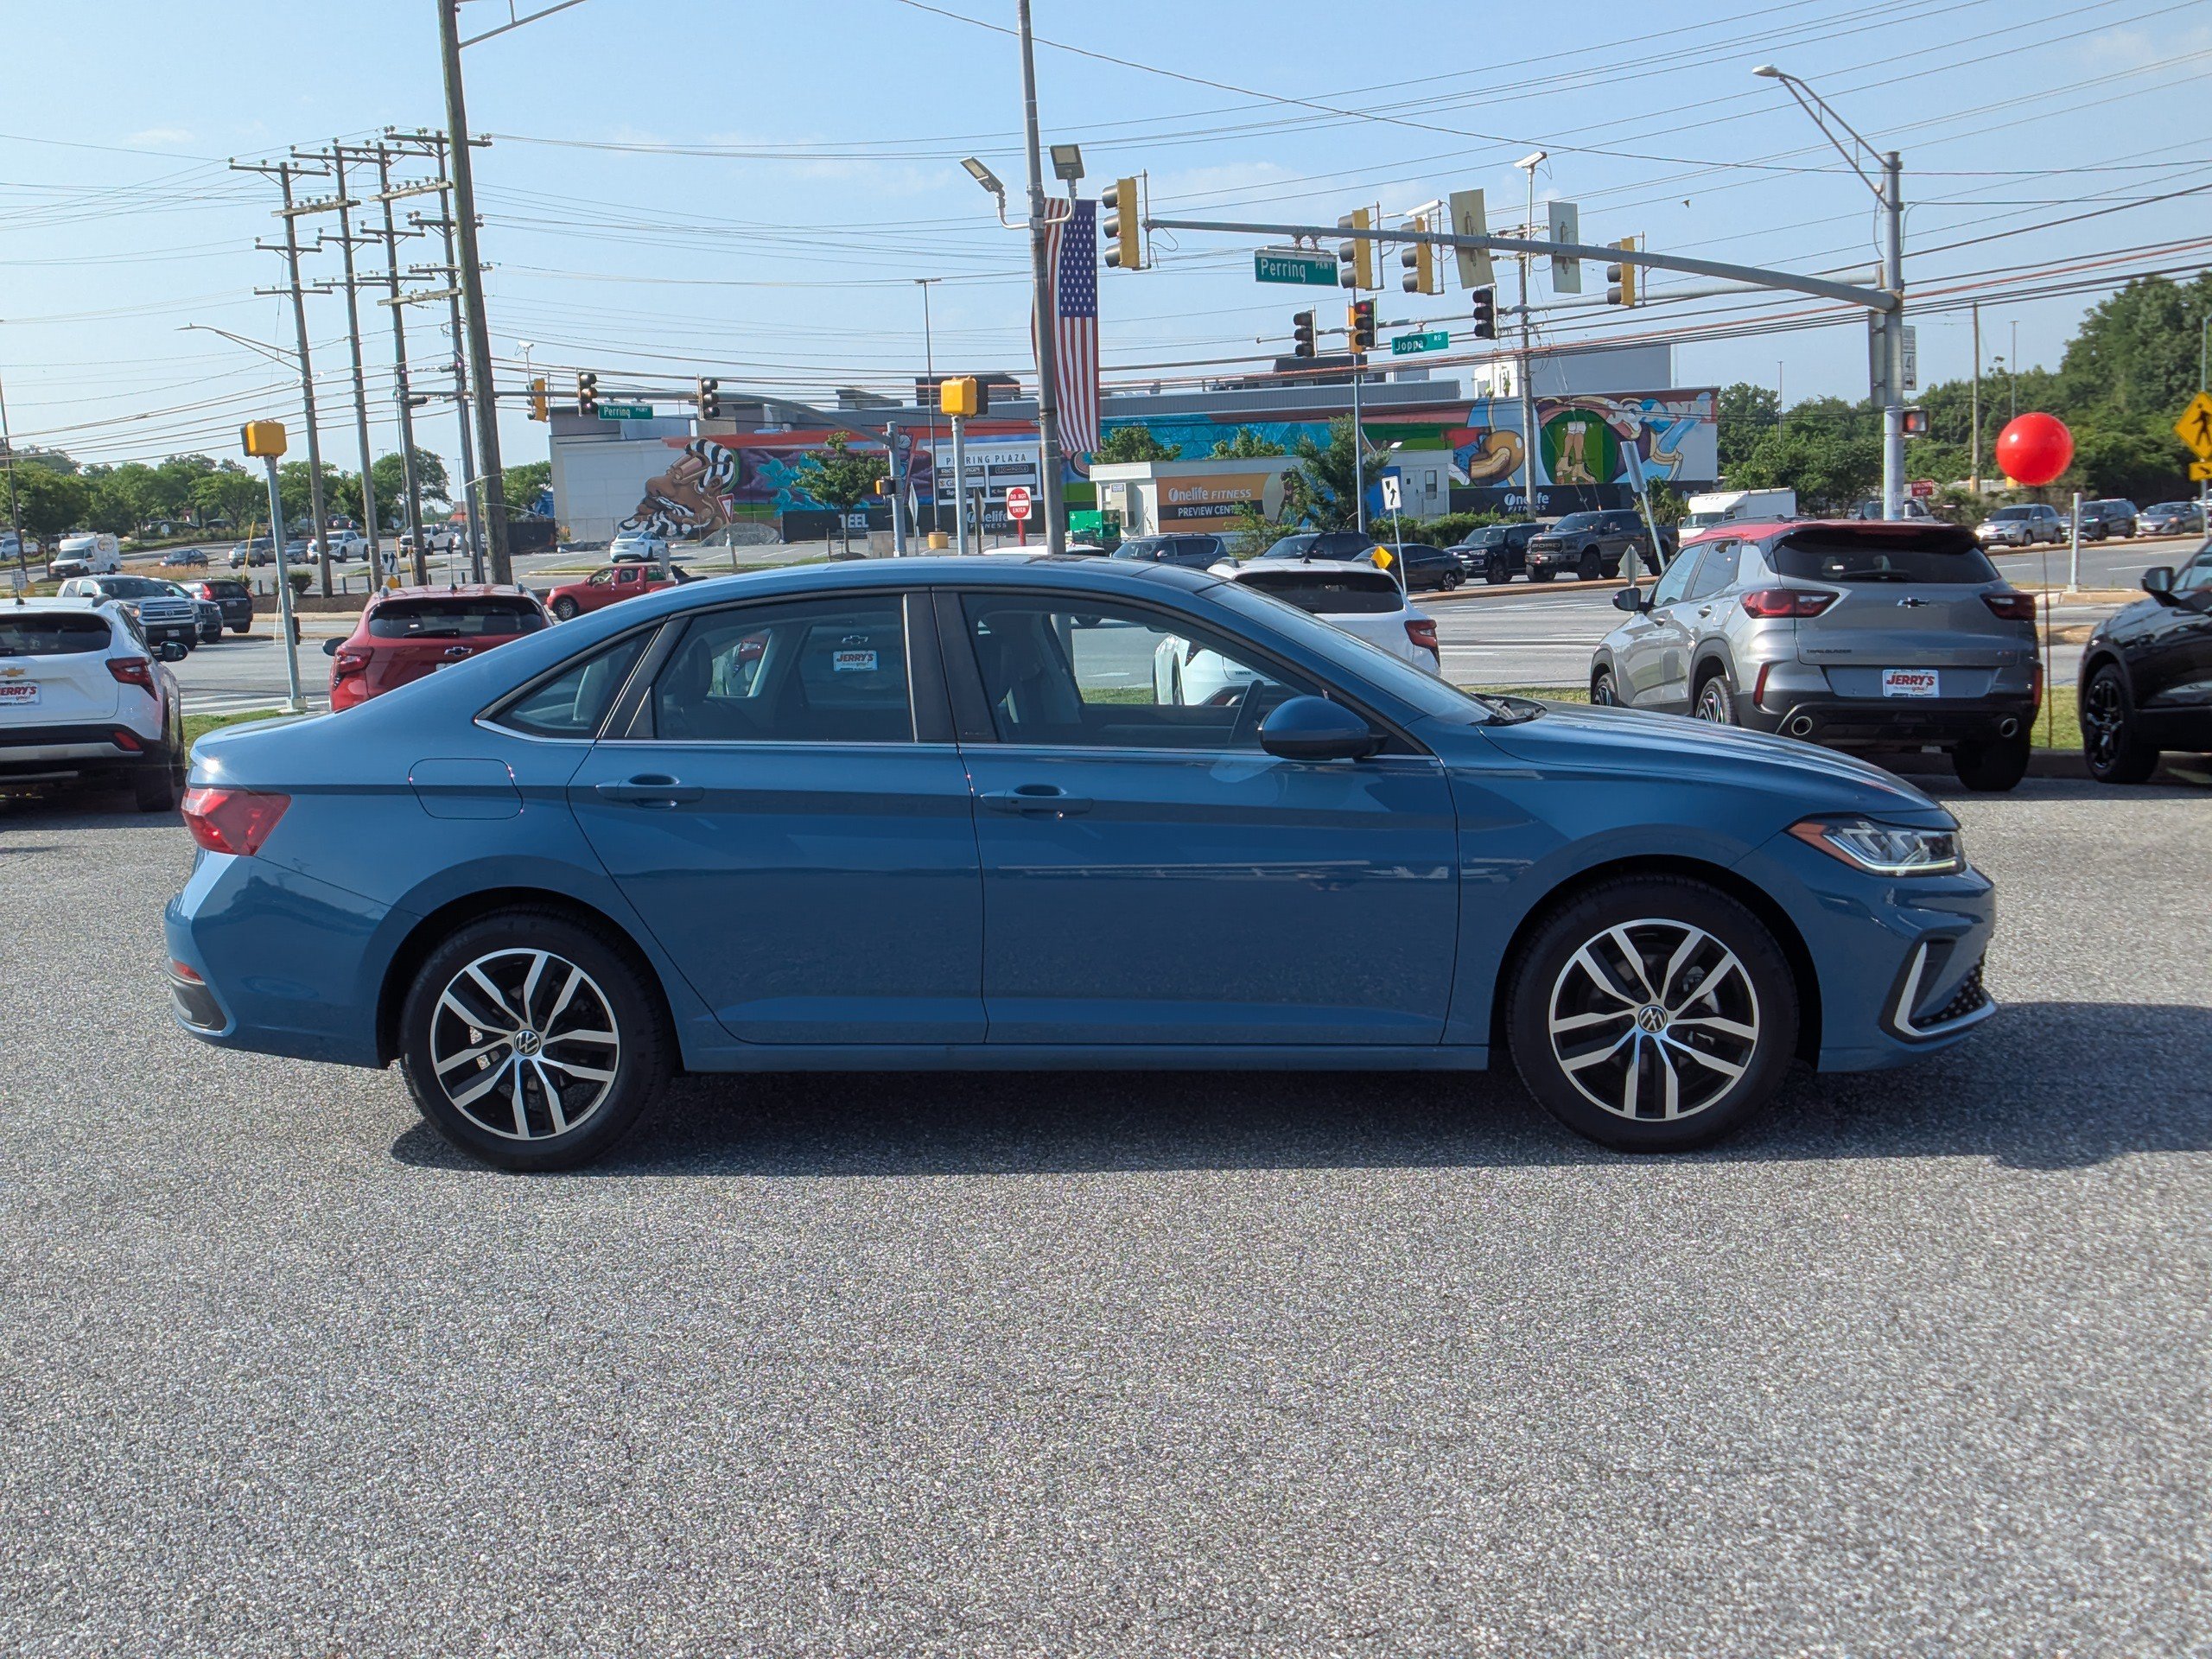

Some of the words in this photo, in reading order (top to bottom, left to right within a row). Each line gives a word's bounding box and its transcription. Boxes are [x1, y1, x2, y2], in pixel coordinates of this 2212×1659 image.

[1261, 257, 1306, 283] Perring
[1315, 260, 1332, 270] PKWY
[1395, 340, 1424, 352] Joppa
[603, 406, 631, 419] Perring
[945, 454, 990, 465] PRING
[995, 453, 1027, 463] PLAZA
[1168, 486, 1209, 502] Onelife
[1211, 488, 1252, 499] FITNESS
[1503, 492, 1549, 506] Onefe
[1178, 505, 1214, 518] PREVIEW
[836, 653, 874, 663] JERRY'S
[1886, 675, 1936, 686] JERRY'S
[0, 686, 37, 696] ERRY'S
